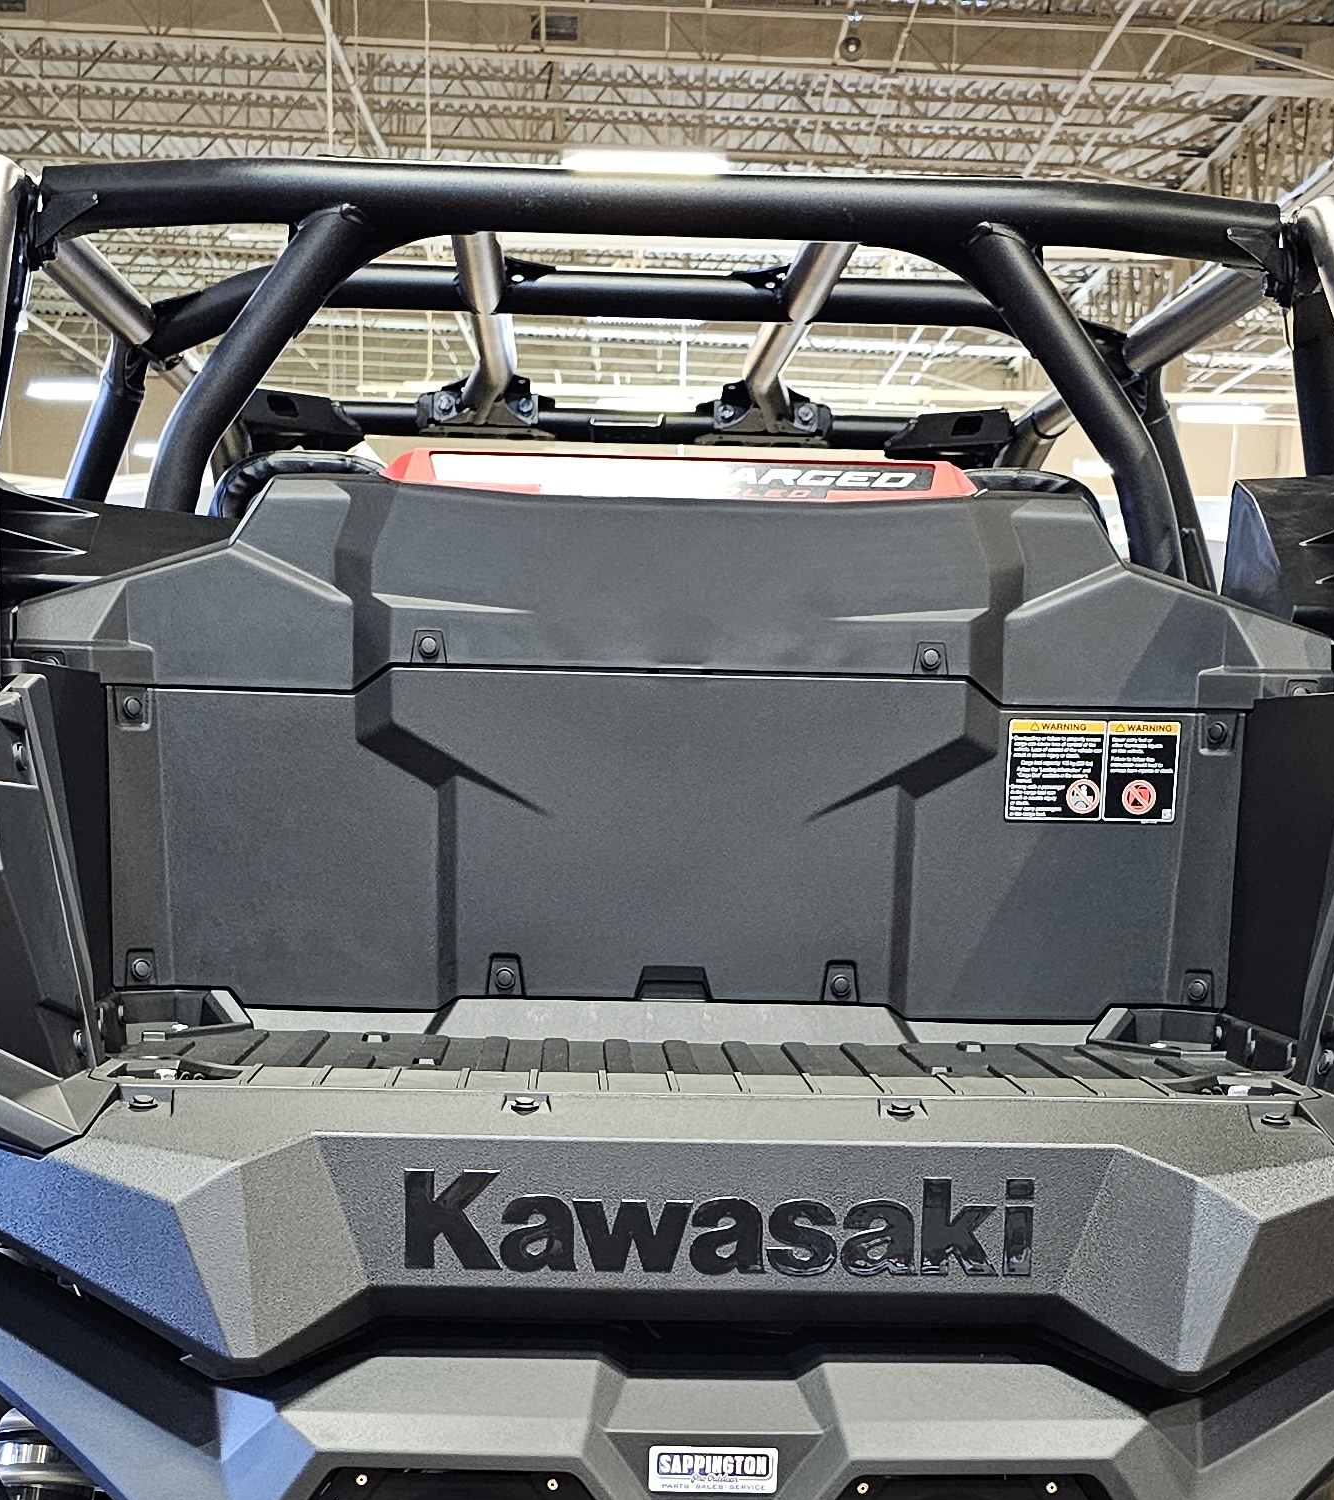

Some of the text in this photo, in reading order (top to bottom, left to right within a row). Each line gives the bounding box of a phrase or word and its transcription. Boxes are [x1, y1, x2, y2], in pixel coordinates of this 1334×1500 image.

[1041, 723, 1087, 731] WARNING
[1127, 724, 1173, 732] WARNING
[404, 1167, 1036, 1277] Kawasaki
[658, 1454, 768, 1475] SAPPINGTON
